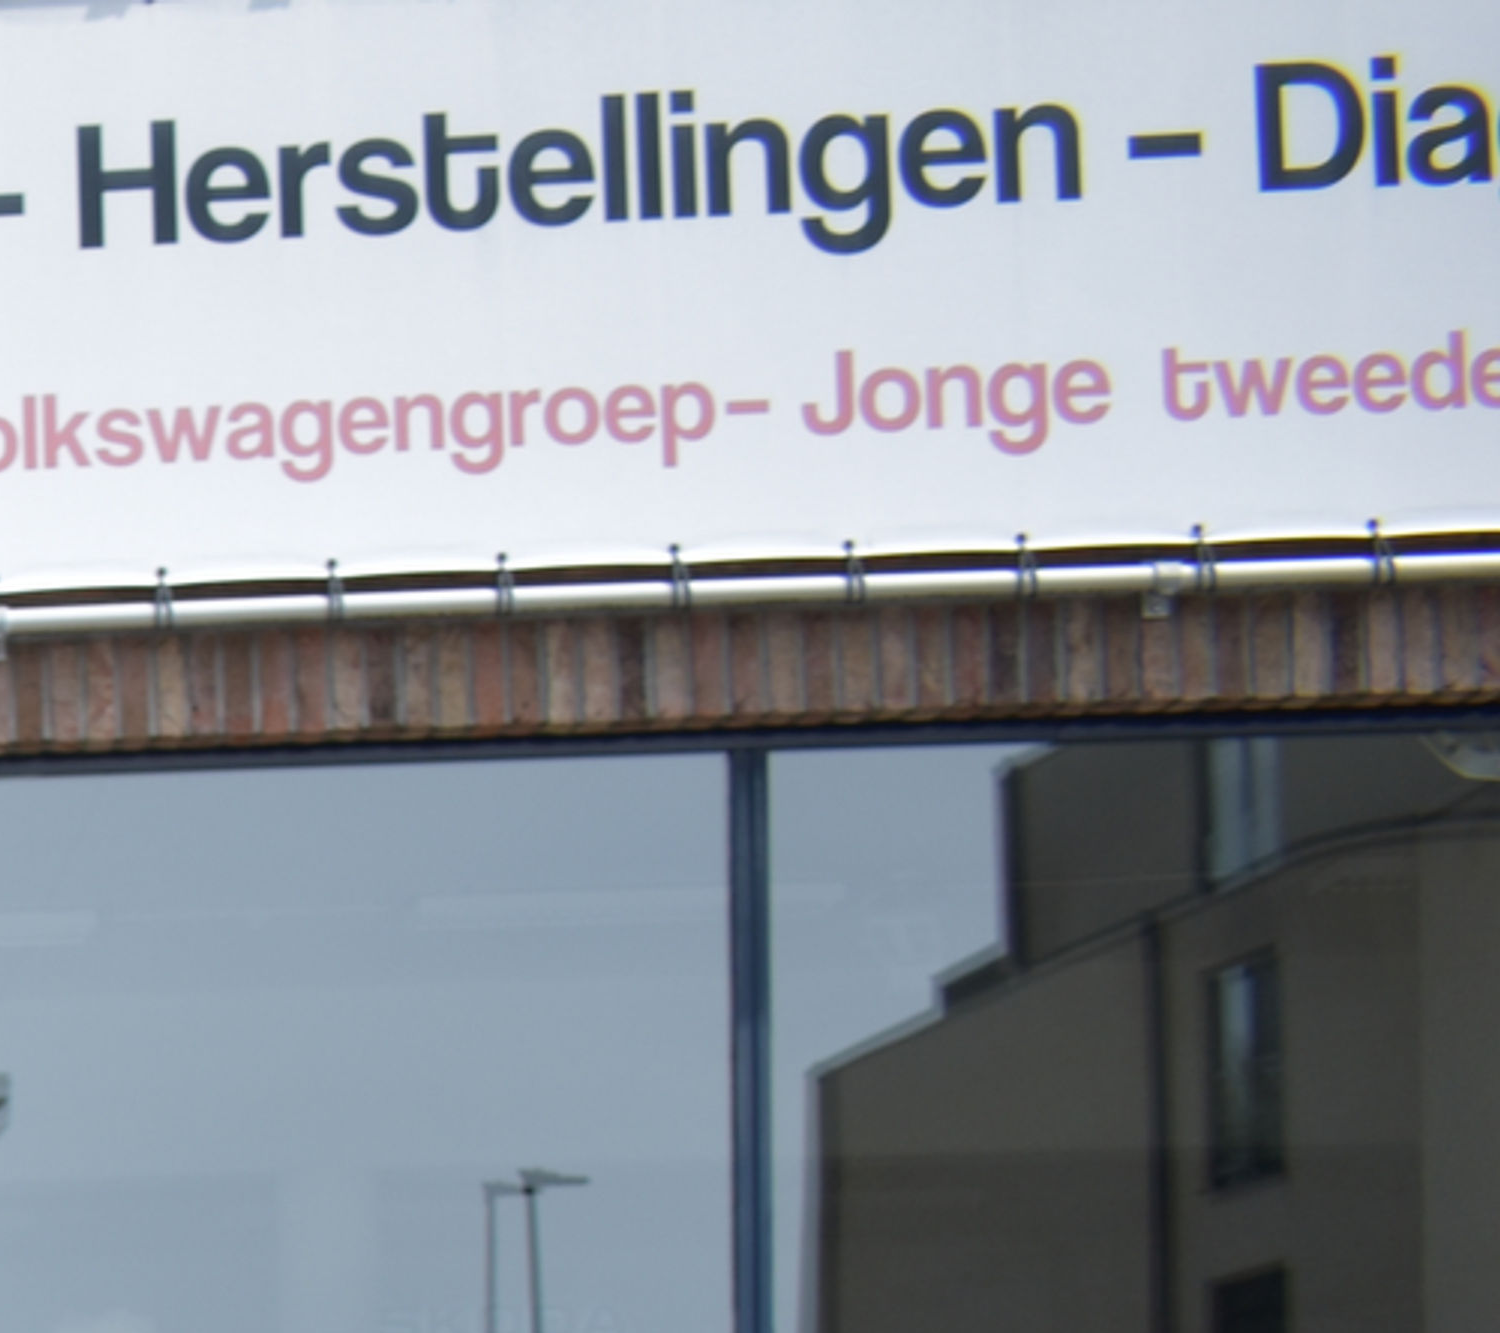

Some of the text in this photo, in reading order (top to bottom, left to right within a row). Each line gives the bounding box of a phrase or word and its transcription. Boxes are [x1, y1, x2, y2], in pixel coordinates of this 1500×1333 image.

[76, 89, 1083, 256] Herstellingen
[1253, 55, 1500, 193] Dia
[801, 349, 1112, 456] Jonge
[1163, 329, 1500, 422] tweede
